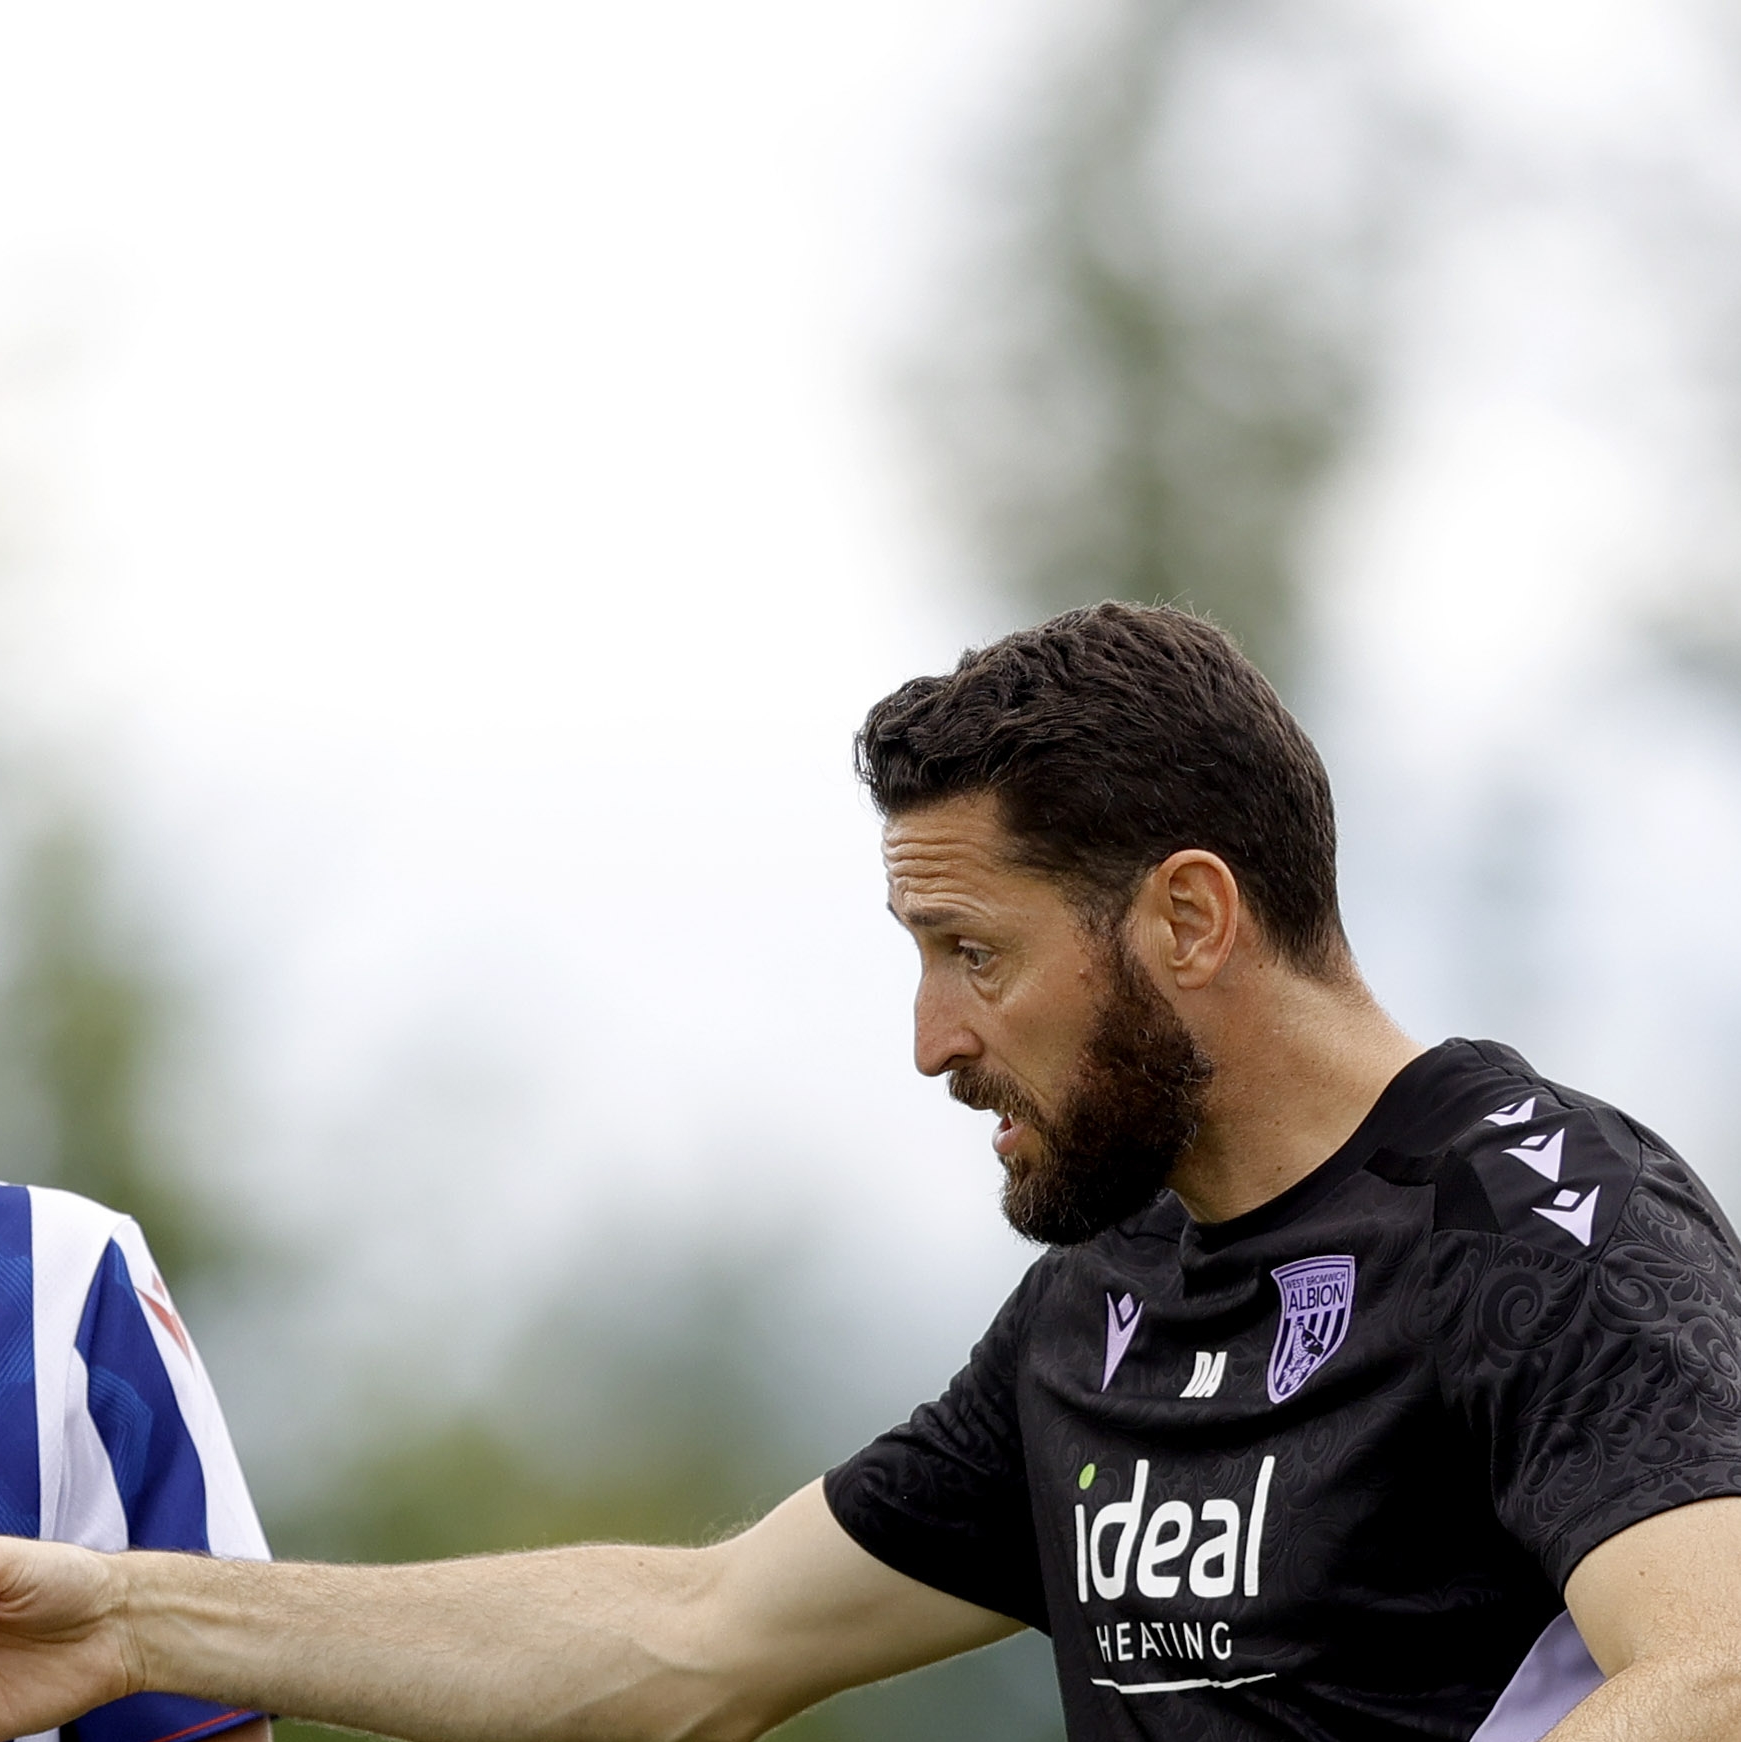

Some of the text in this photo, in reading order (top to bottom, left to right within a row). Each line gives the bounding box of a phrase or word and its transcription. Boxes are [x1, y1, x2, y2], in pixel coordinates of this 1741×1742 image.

[1288, 1282, 1345, 1313] ALBION
[1179, 1351, 1228, 1398] DA
[1074, 1456, 1276, 1602] ideal
[1095, 1620, 1233, 1664] HEATING
